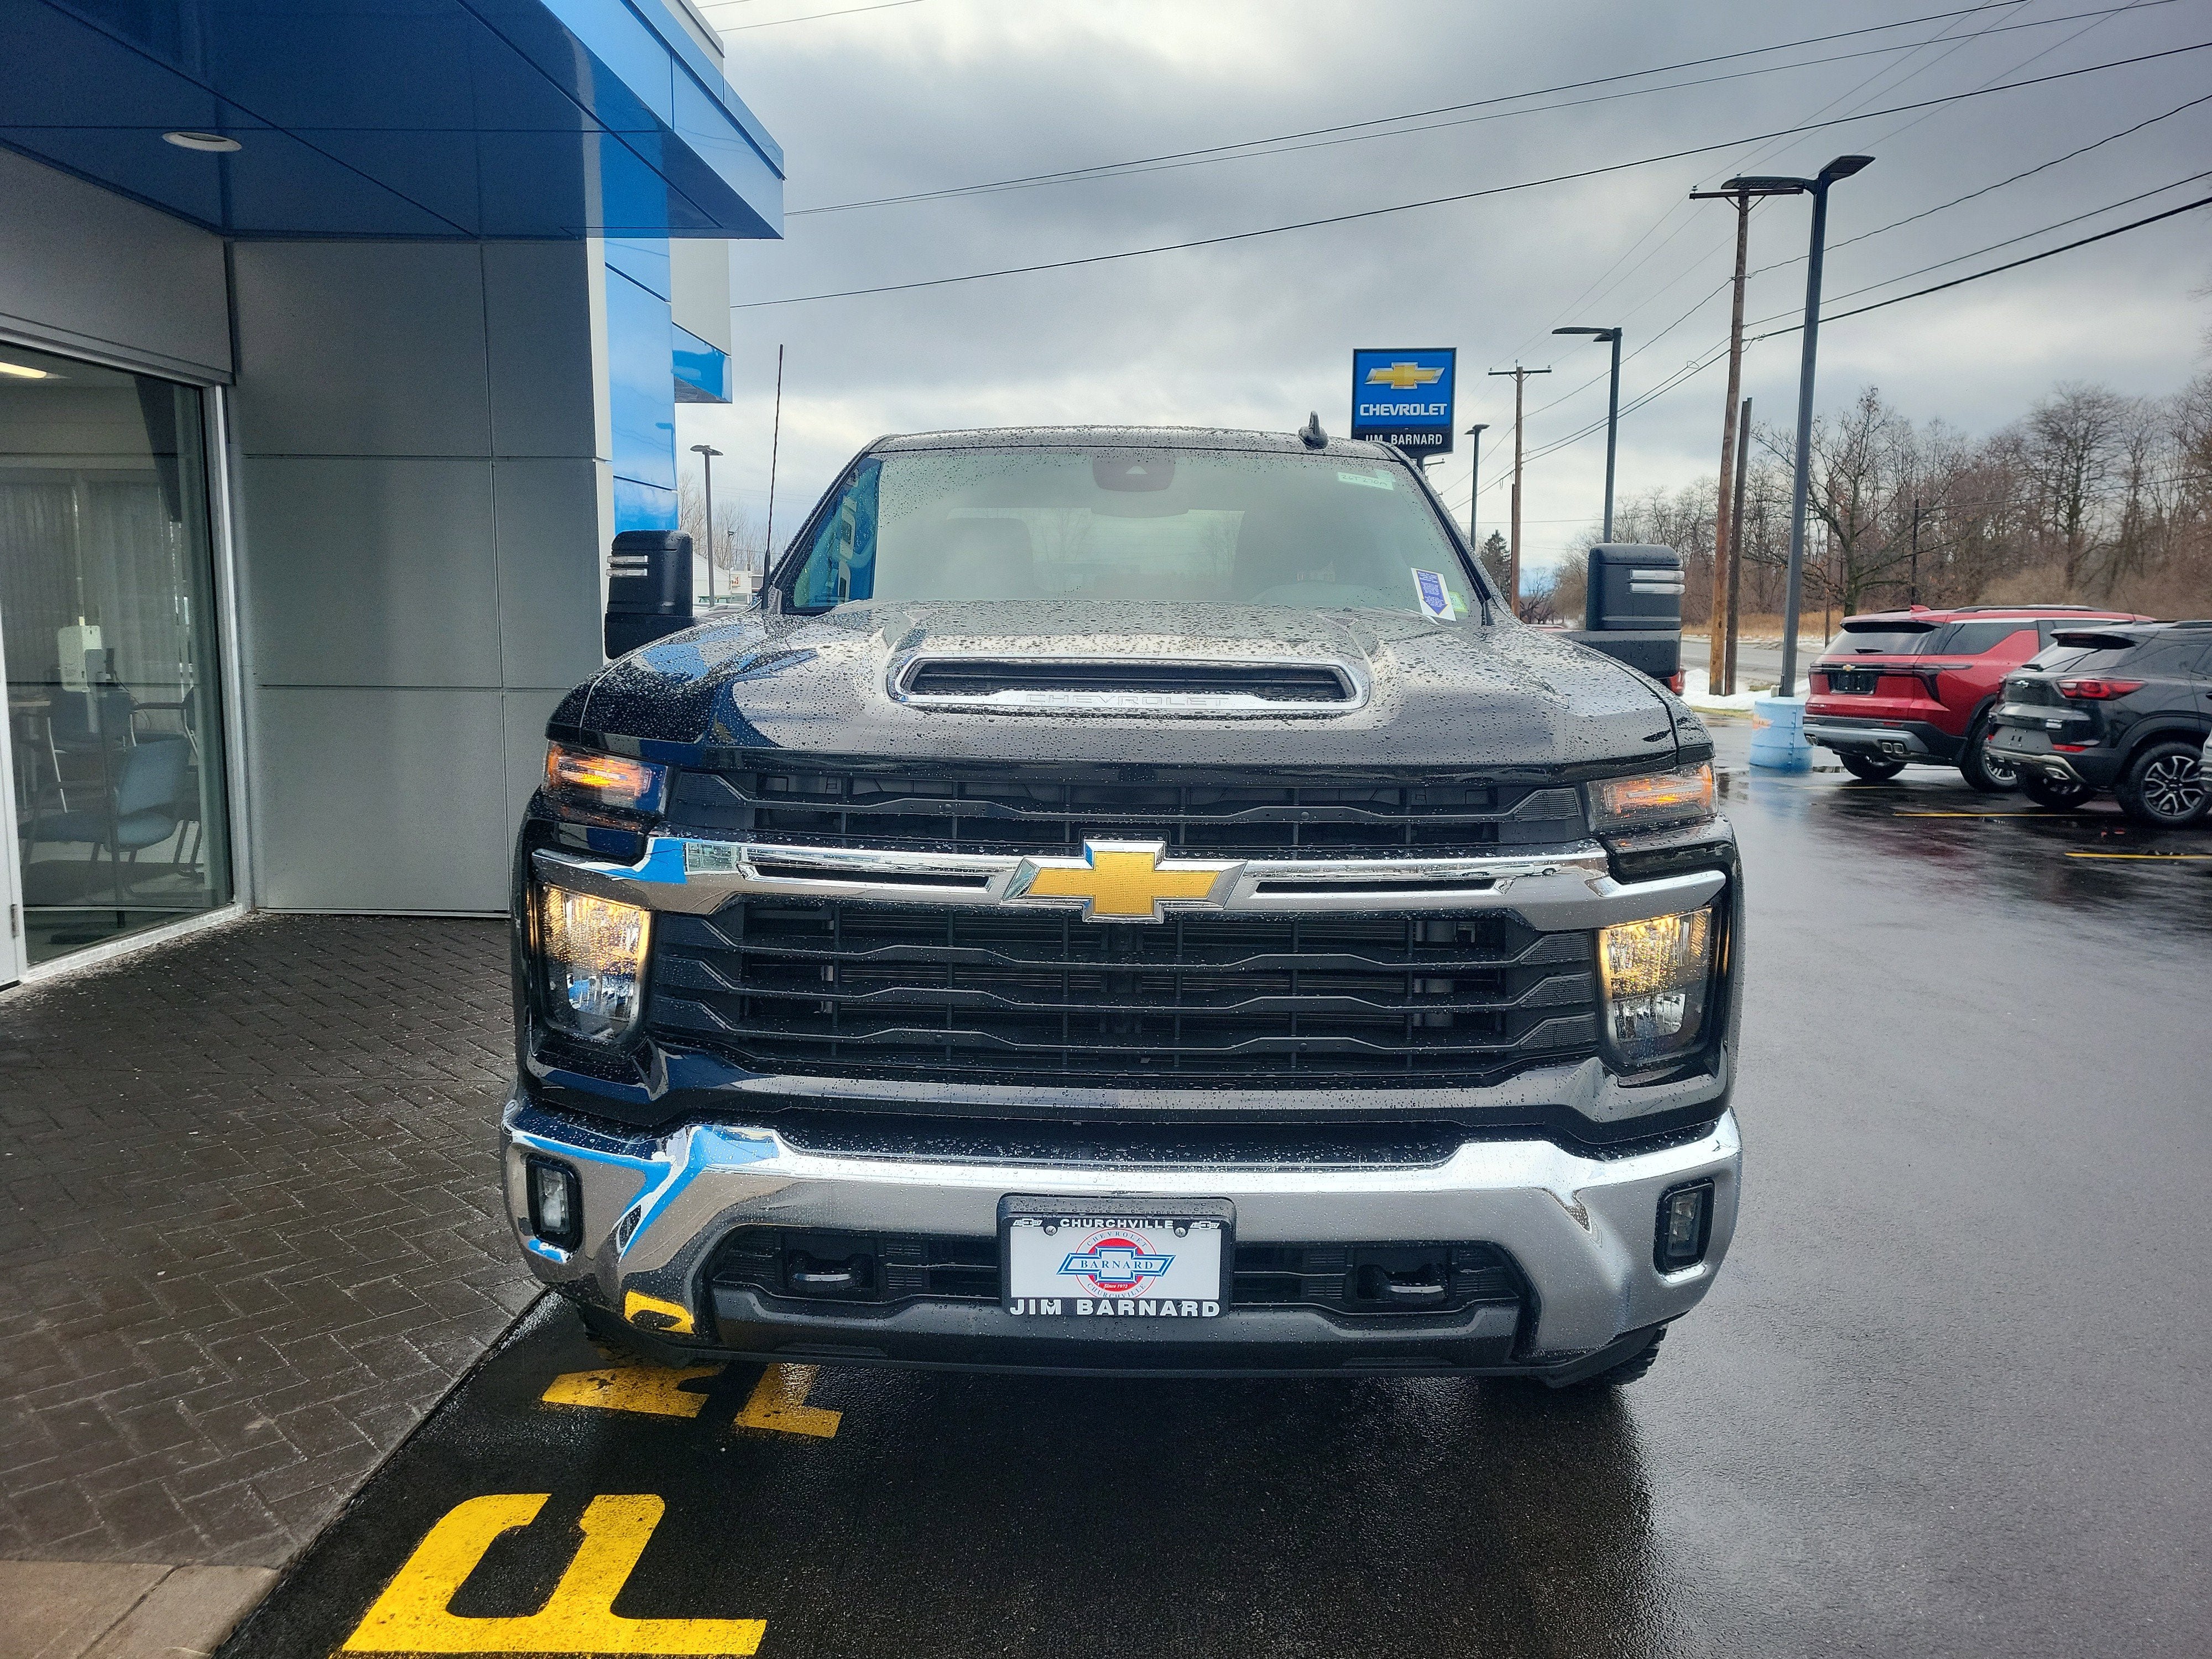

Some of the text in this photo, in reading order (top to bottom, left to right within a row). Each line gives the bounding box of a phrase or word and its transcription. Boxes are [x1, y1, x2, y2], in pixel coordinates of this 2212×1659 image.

[1360, 403, 1447, 416] CHEVROLET
[1391, 434, 1443, 445] BARNARD
[1026, 694, 1229, 707] CHEVROLET
[1060, 1218, 1173, 1229] CHURCHVILLE
[1087, 1231, 1148, 1247] CHEVROLET
[1080, 1260, 1154, 1270] BARNARD
[1010, 1299, 1220, 1317] JIM BARNARD
